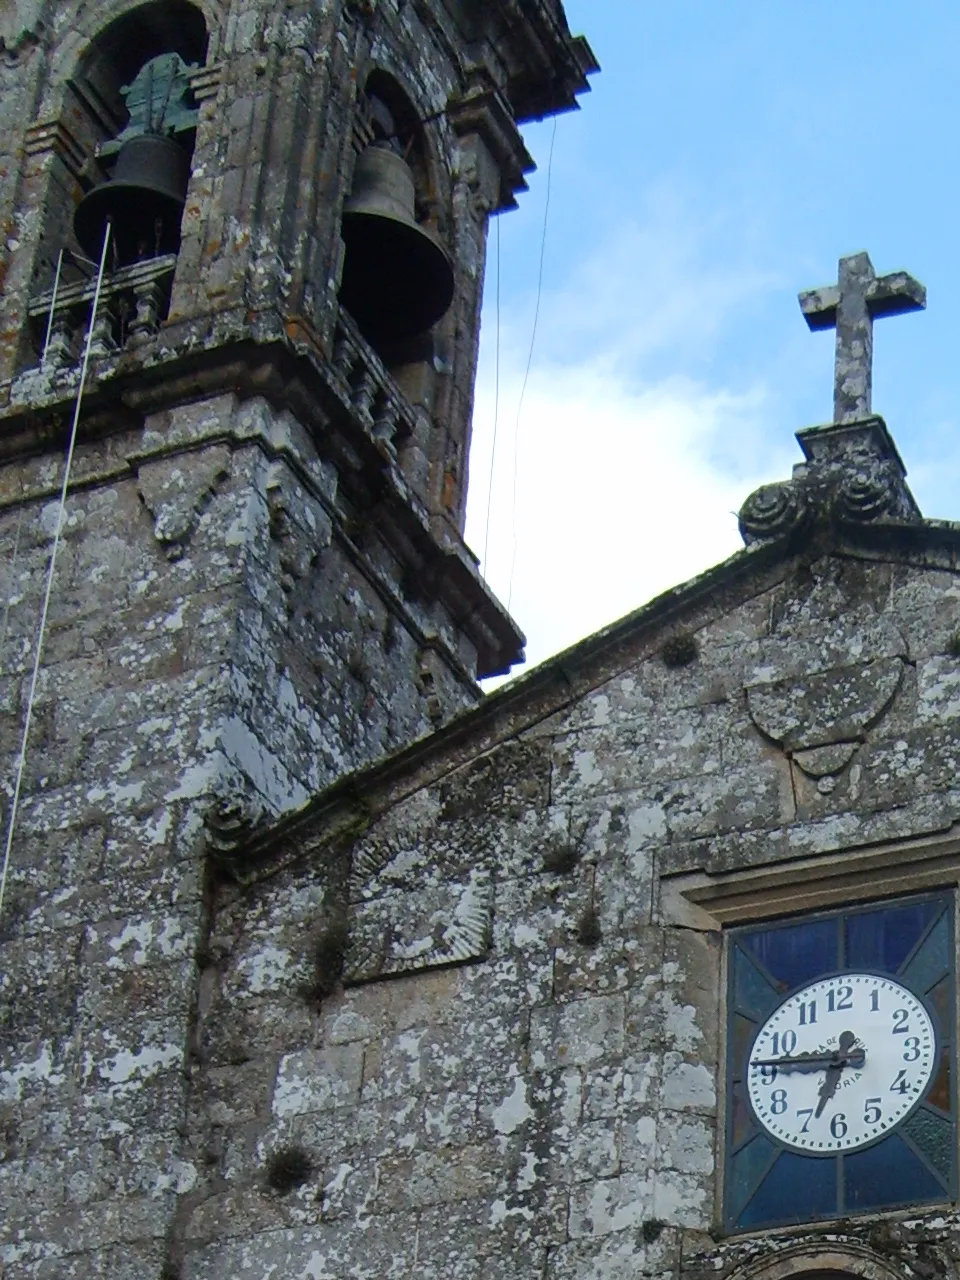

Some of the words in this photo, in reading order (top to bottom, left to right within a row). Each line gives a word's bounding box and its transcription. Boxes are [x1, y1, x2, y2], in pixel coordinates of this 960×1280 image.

[826, 986, 853, 1012] 12
[869, 989, 880, 1012] 1
[798, 1000, 817, 1026] 11
[892, 1009, 910, 1034] 2
[770, 1030, 796, 1056] 10
[903, 1036, 921, 1061] 3
[761, 1064, 778, 1086] 9
[889, 1069, 911, 1095] 4
[770, 1089, 788, 1115] 8
[864, 1097, 882, 1124] 5
[796, 1108, 814, 1134] 7
[830, 1113, 848, 1139] 6
